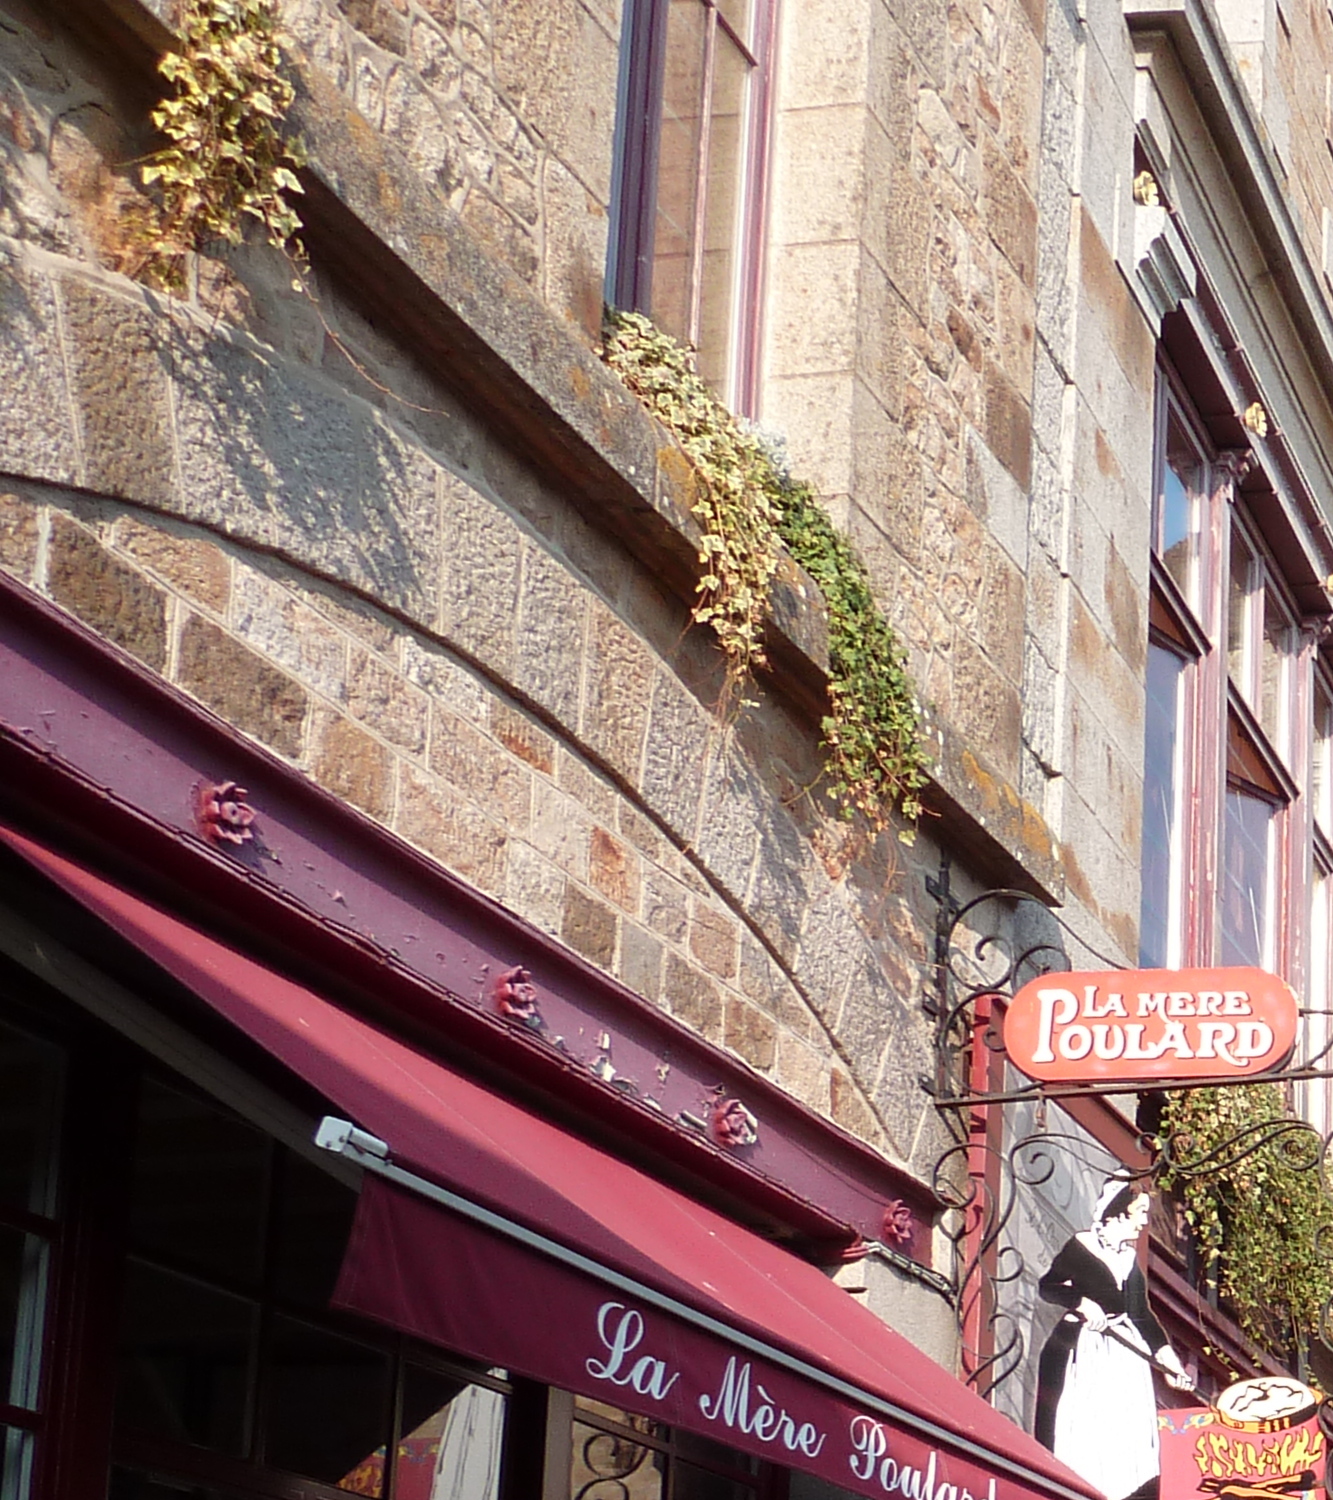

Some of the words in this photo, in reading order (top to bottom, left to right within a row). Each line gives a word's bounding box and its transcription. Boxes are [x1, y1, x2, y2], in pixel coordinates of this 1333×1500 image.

[1082, 985, 1129, 1018] LA
[1136, 990, 1252, 1024] MERE
[585, 1301, 680, 1401] La
[699, 1355, 827, 1458] Mère
